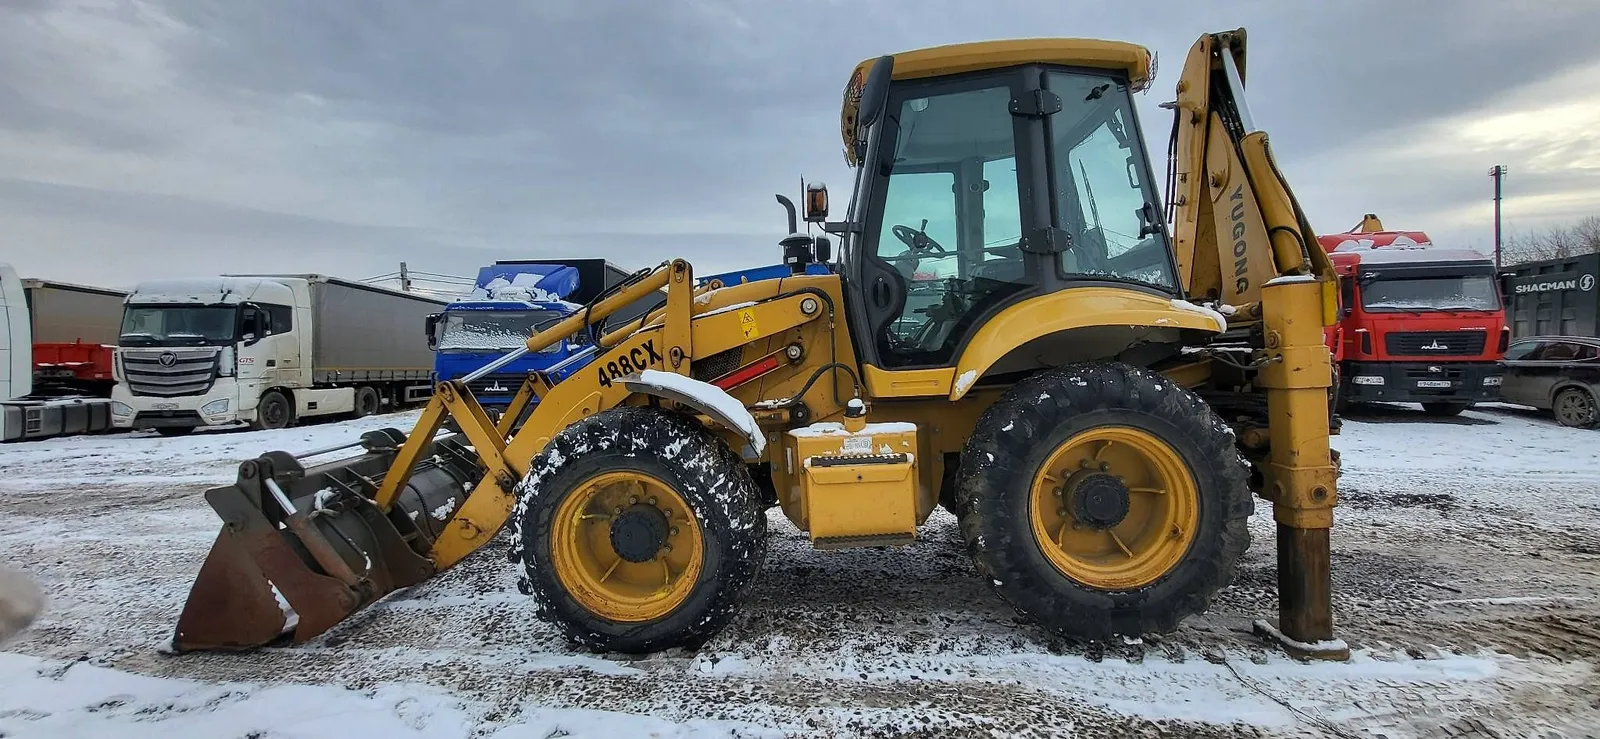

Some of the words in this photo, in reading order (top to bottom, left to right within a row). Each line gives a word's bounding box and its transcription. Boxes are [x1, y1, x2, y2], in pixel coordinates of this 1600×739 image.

[1230, 184, 1249, 295] YUGONG
[1515, 280, 1576, 294] SHACMAN
[598, 339, 663, 388] 488CX
